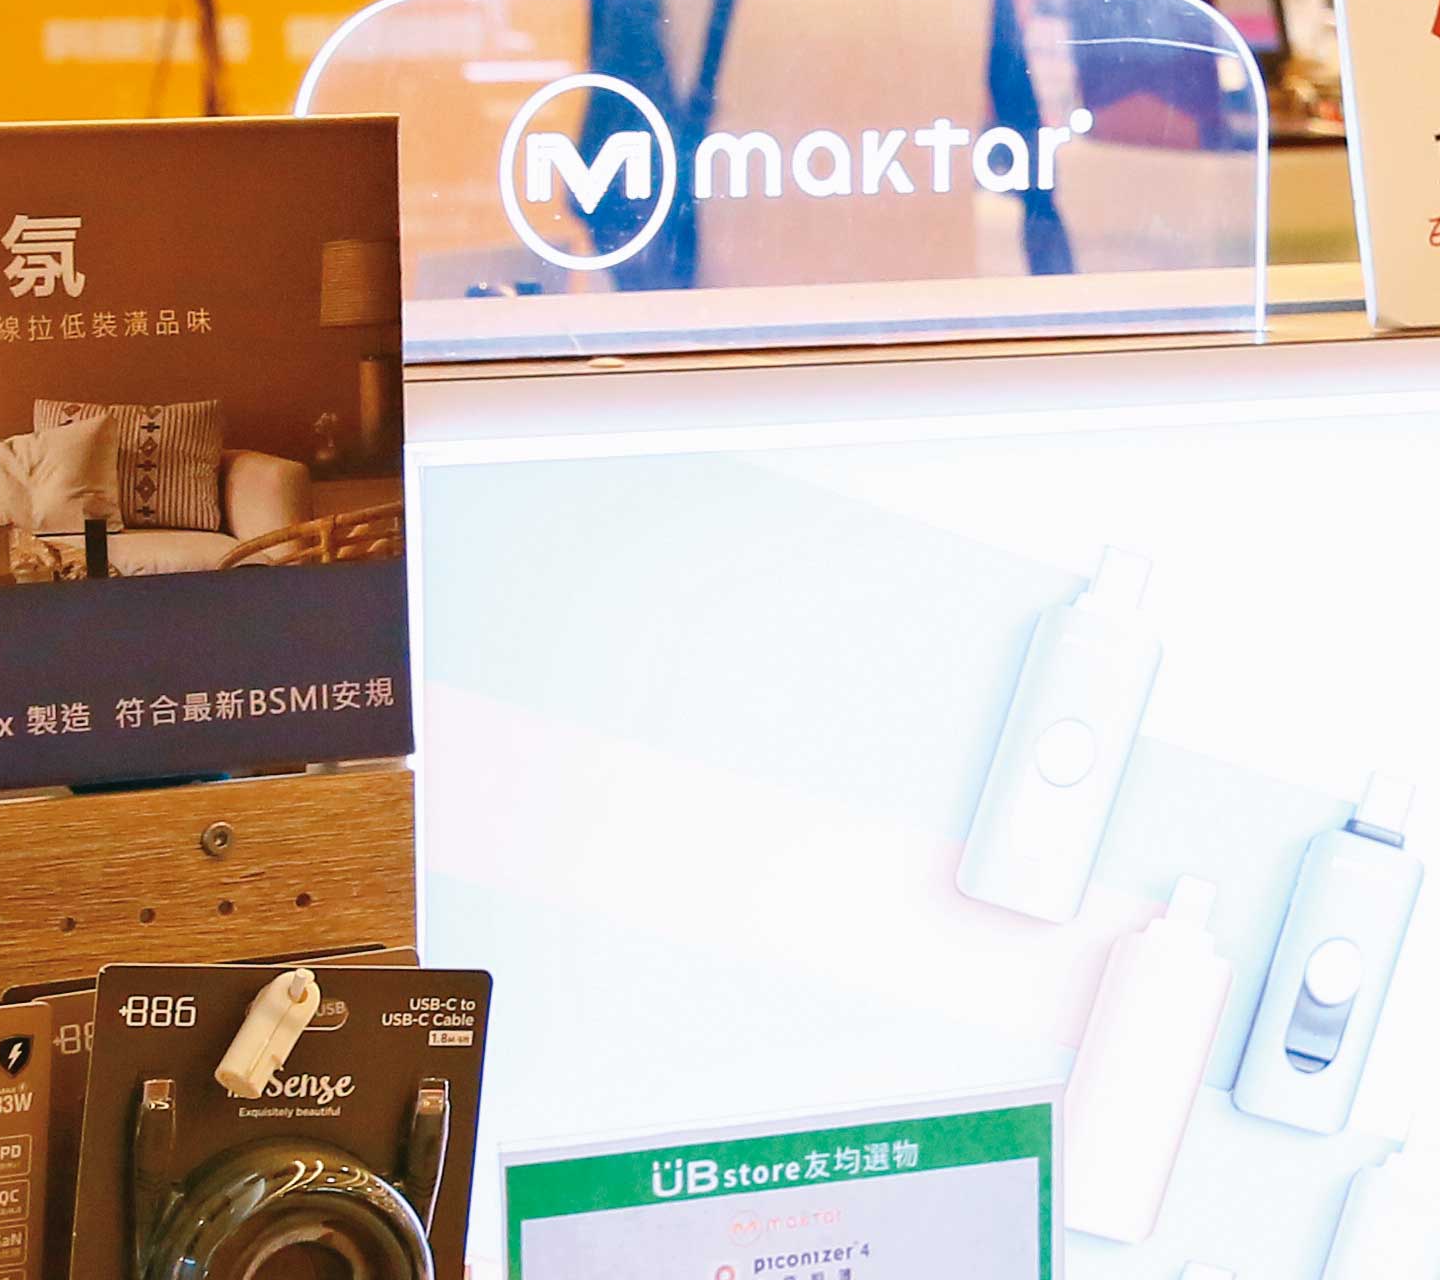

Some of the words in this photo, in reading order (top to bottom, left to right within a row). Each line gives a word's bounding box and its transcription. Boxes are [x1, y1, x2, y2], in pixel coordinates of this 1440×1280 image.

[695, 118, 1073, 199] maktar
[27, 702, 92, 736] 製造
[115, 678, 395, 729] 符合最新BSMI安規
[410, 998, 457, 1011] USB-C
[461, 999, 475, 1011] to
[382, 1013, 429, 1027] USB-C
[433, 1013, 474, 1027] Cable
[239, 1107, 293, 1118] Exquisitely
[296, 1106, 341, 1117] beautiful
[0, 1145, 21, 1160] PD
[805, 1139, 919, 1181] 友均選物
[754, 1244, 854, 1272] piconizer
[860, 1243, 870, 1258] 4
